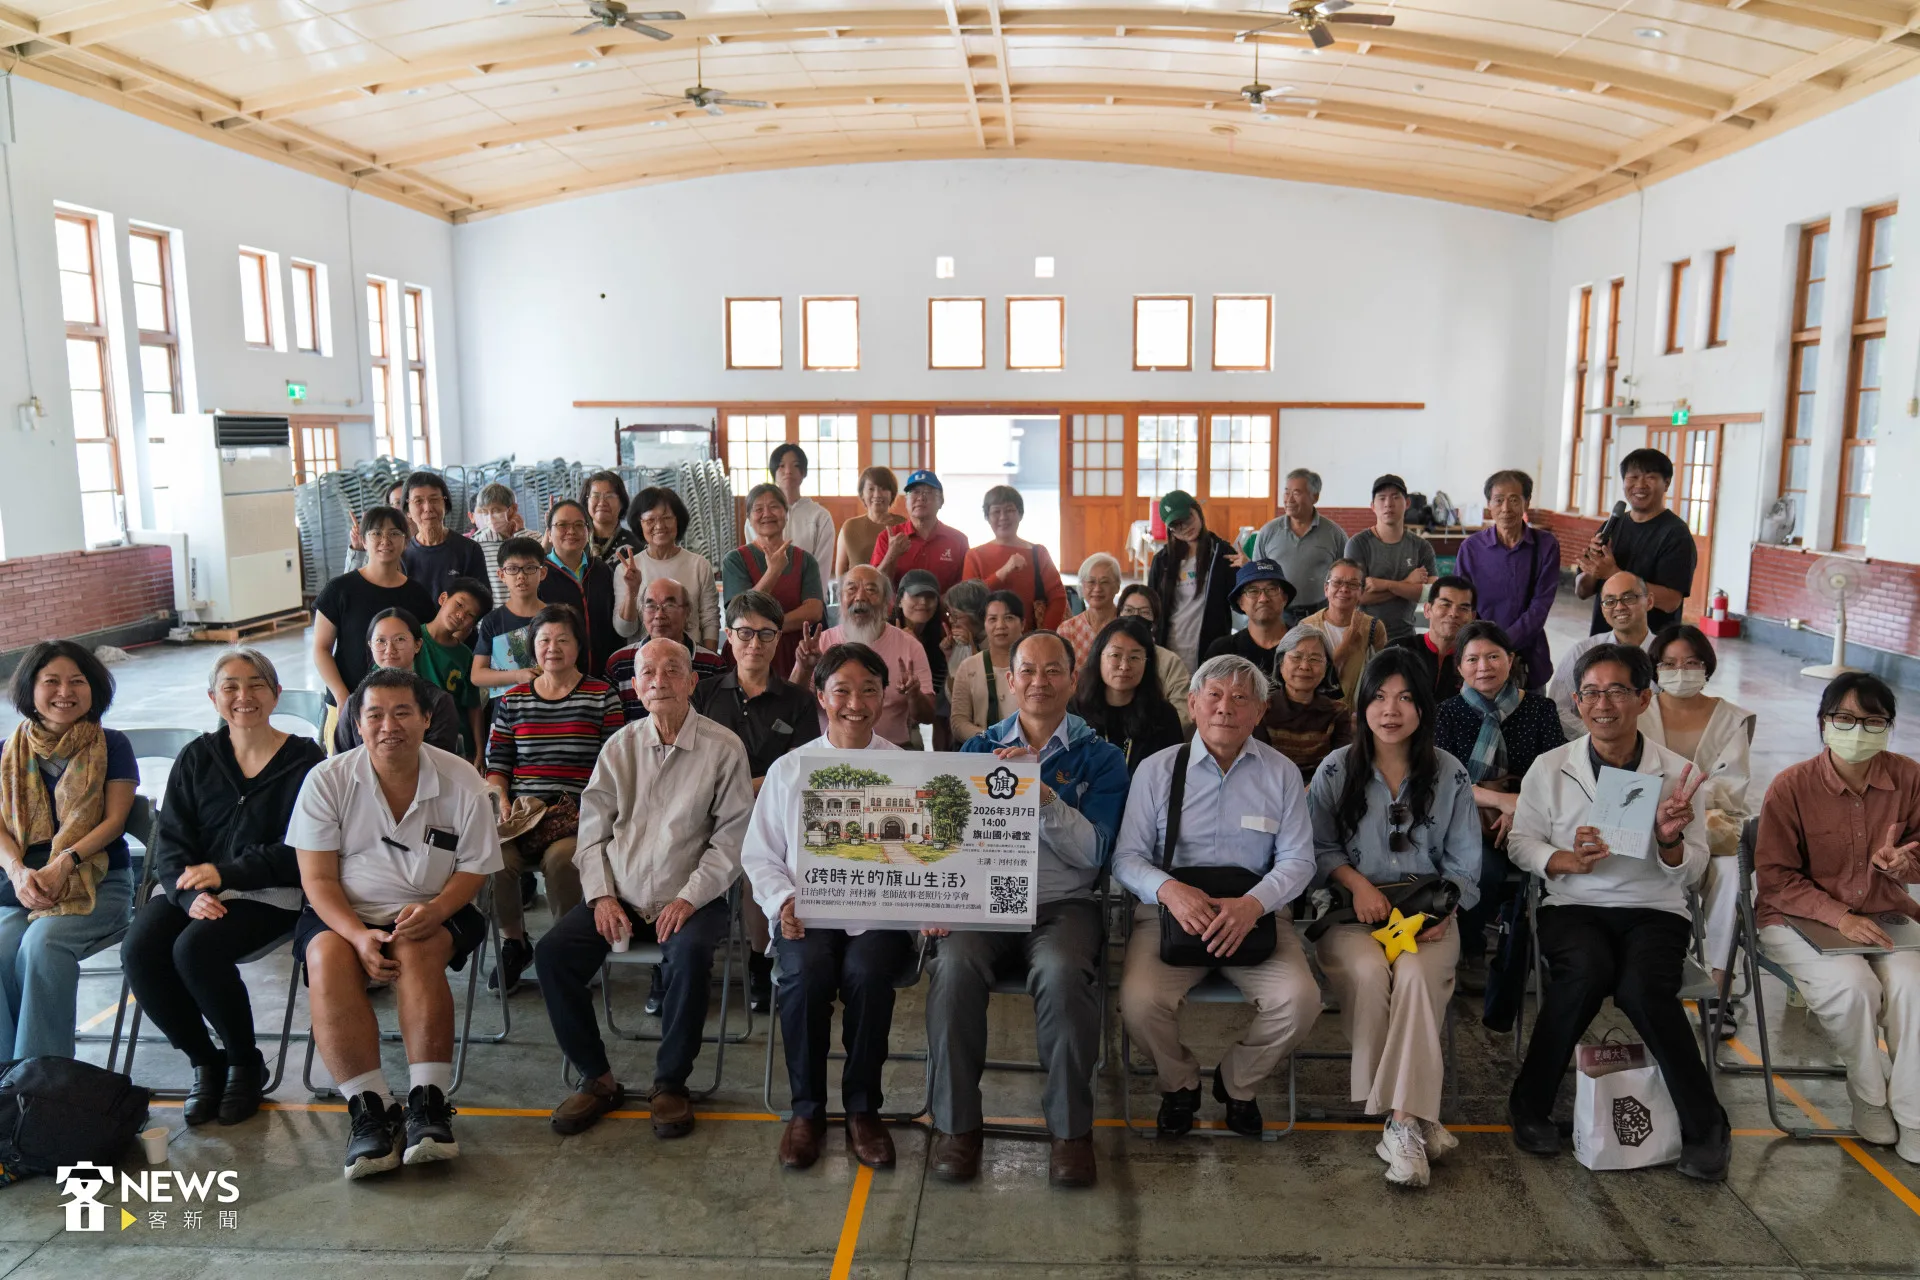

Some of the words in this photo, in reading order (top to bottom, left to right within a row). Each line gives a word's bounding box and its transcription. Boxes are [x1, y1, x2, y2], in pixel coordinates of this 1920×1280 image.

[994, 776, 1010, 791] 旗
[973, 806, 1035, 817] 2026年3月7日
[981, 818, 1007, 827] 14:00
[972, 830, 1032, 841] 旗山國小禮堂
[801, 887, 846, 897] 日治時代的
